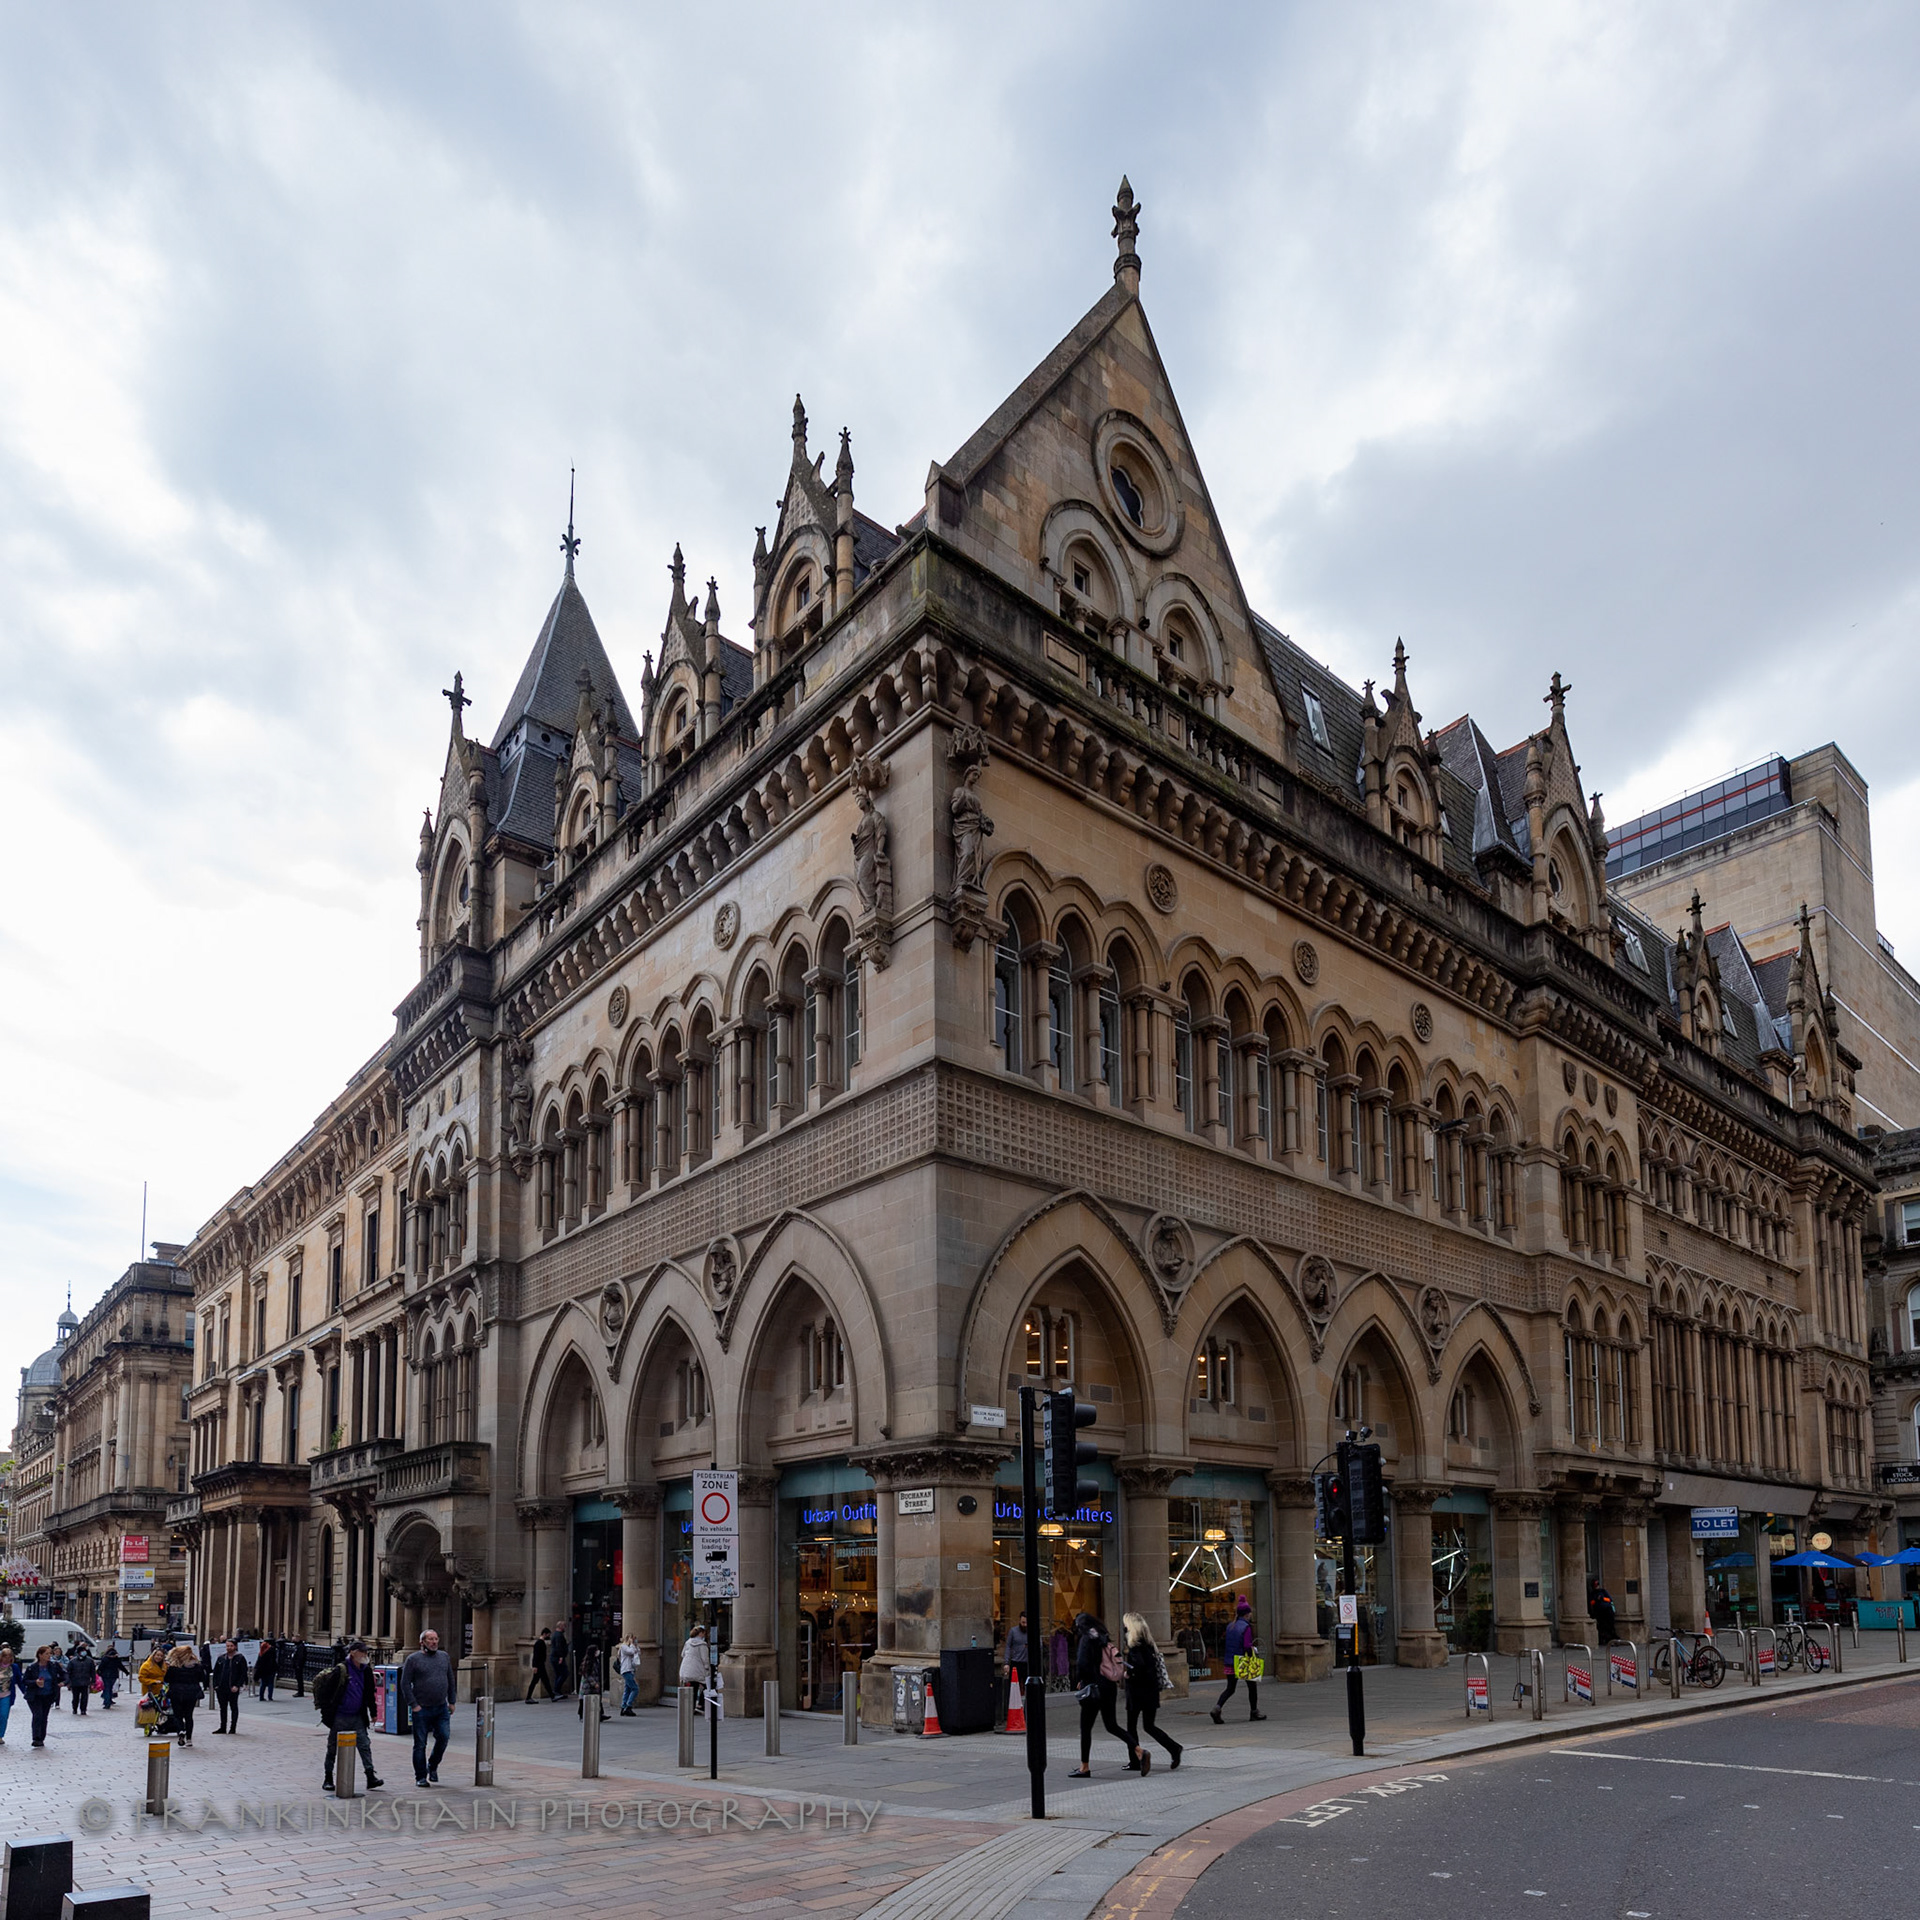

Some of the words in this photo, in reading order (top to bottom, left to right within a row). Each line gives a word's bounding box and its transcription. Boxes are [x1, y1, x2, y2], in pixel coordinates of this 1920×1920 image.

[702, 1481, 729, 1489] ZONE
[900, 1491, 931, 1500] BUCHANAN
[905, 1500, 928, 1508] STREET
[803, 1509, 837, 1524] Urban
[842, 1503, 877, 1520] Outfit
[1694, 1519, 1710, 1528] TO
[1713, 1518, 1735, 1528] LET
[1353, 1773, 1450, 1798] LOOK
[1278, 1798, 1368, 1828] LEFT
